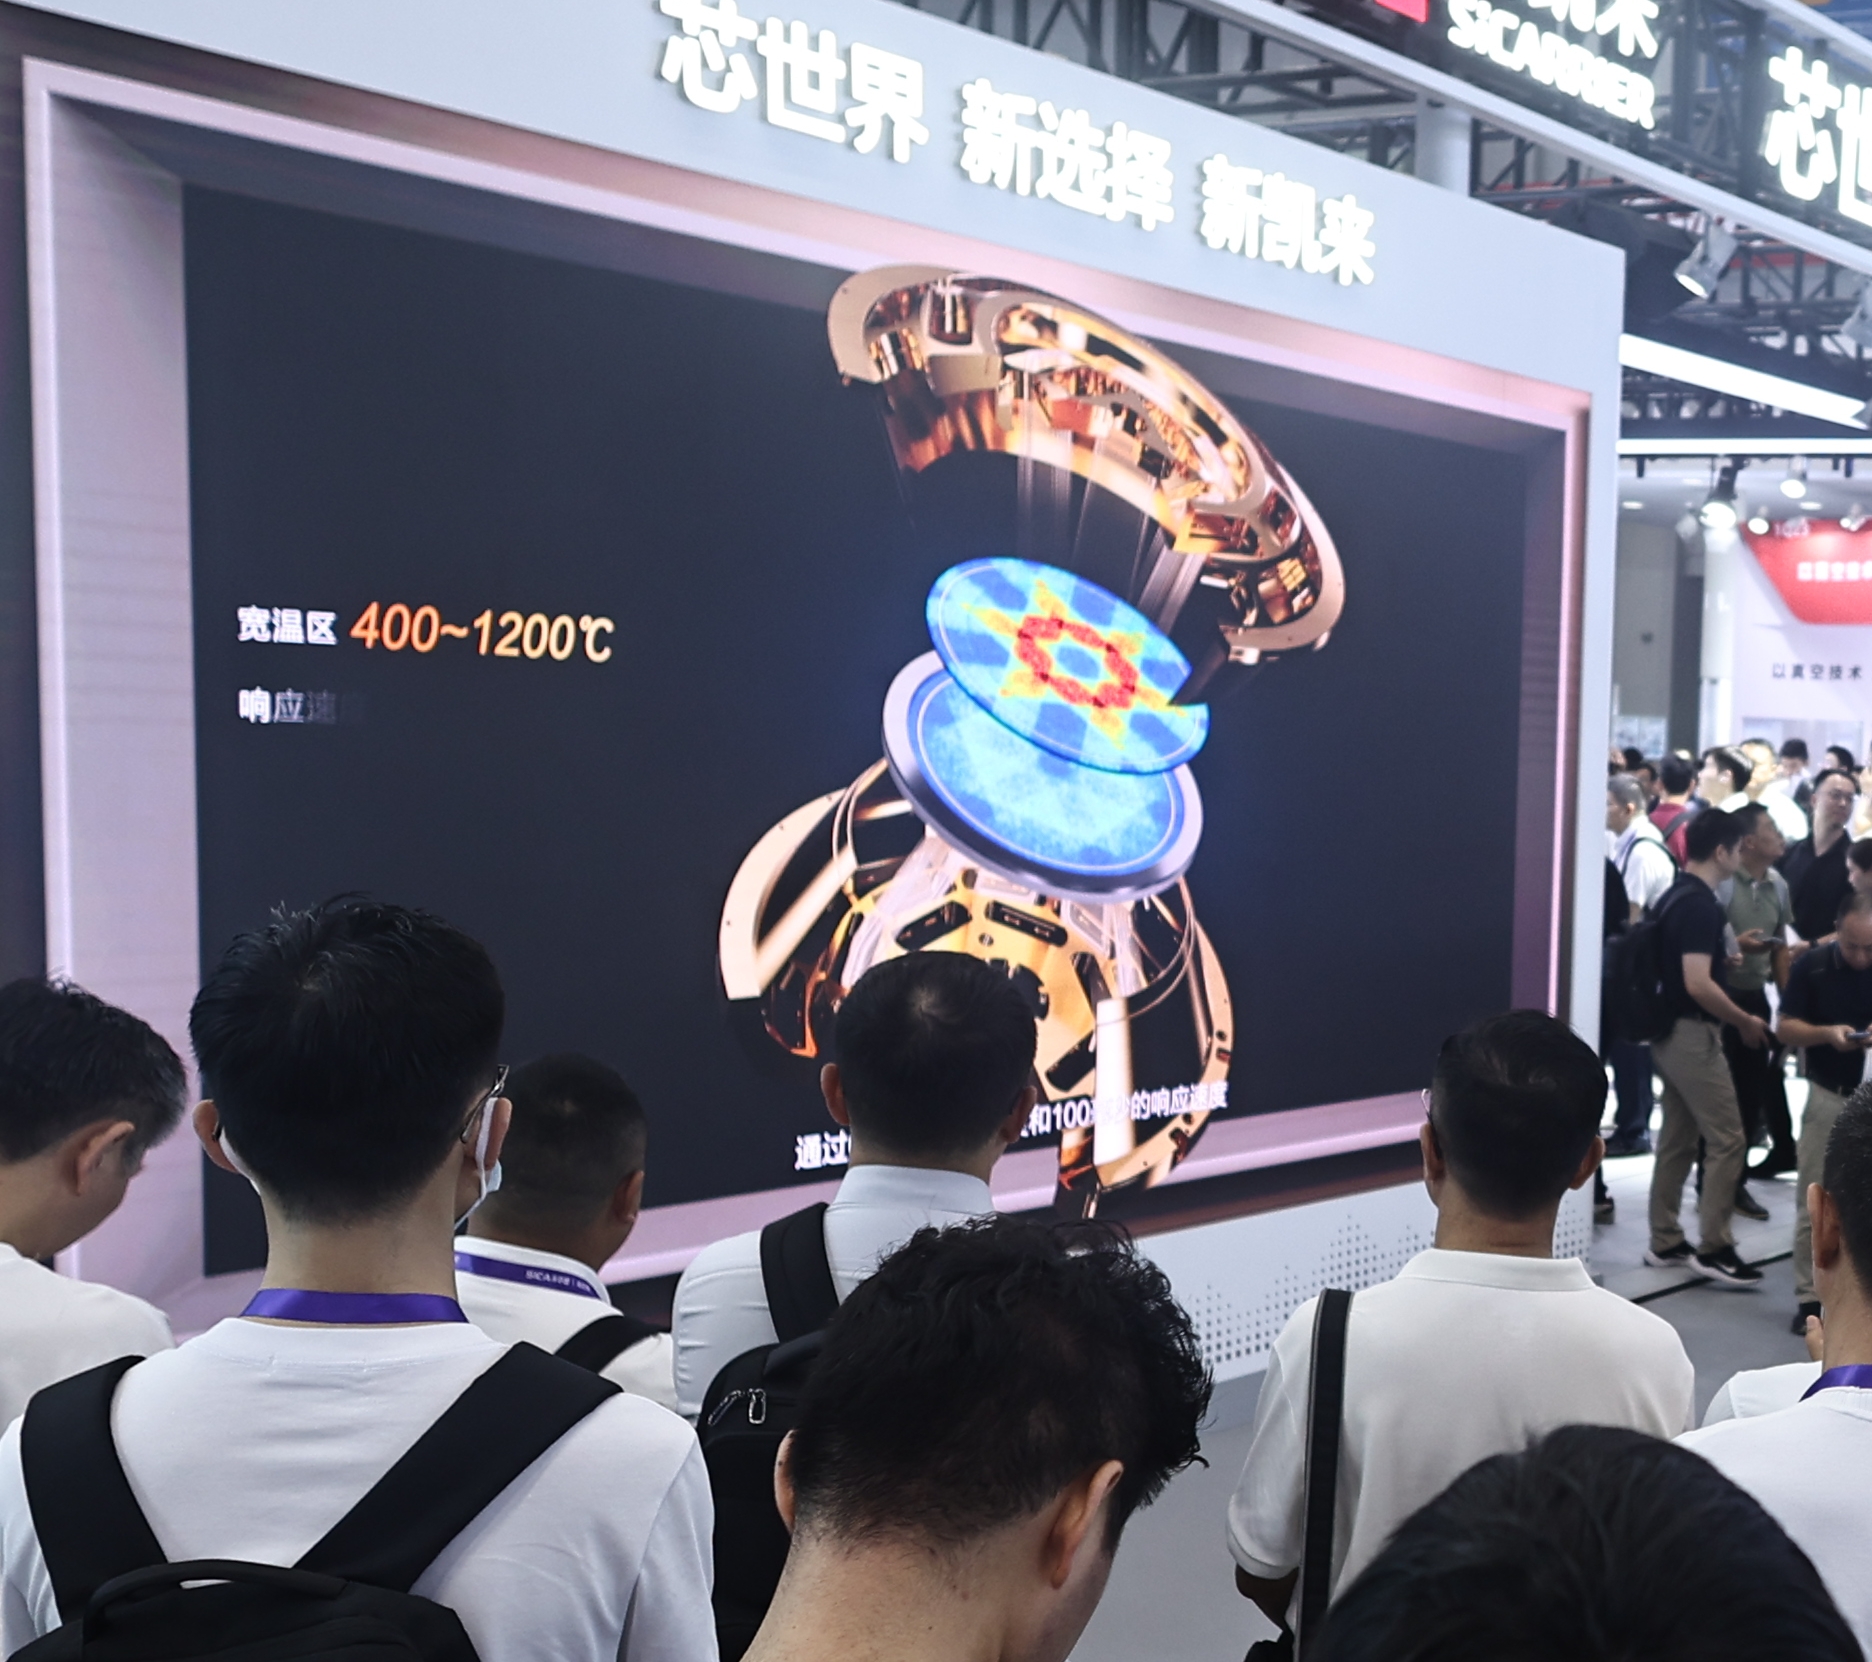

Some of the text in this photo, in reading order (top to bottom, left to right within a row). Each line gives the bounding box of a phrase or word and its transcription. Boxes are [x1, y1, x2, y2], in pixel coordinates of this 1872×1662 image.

[660, 0, 1377, 287] 芯世界 新选择 新凯来
[237, 604, 338, 646] 宽温区
[237, 686, 368, 725] 响应速
[794, 1129, 852, 1171] 通过
